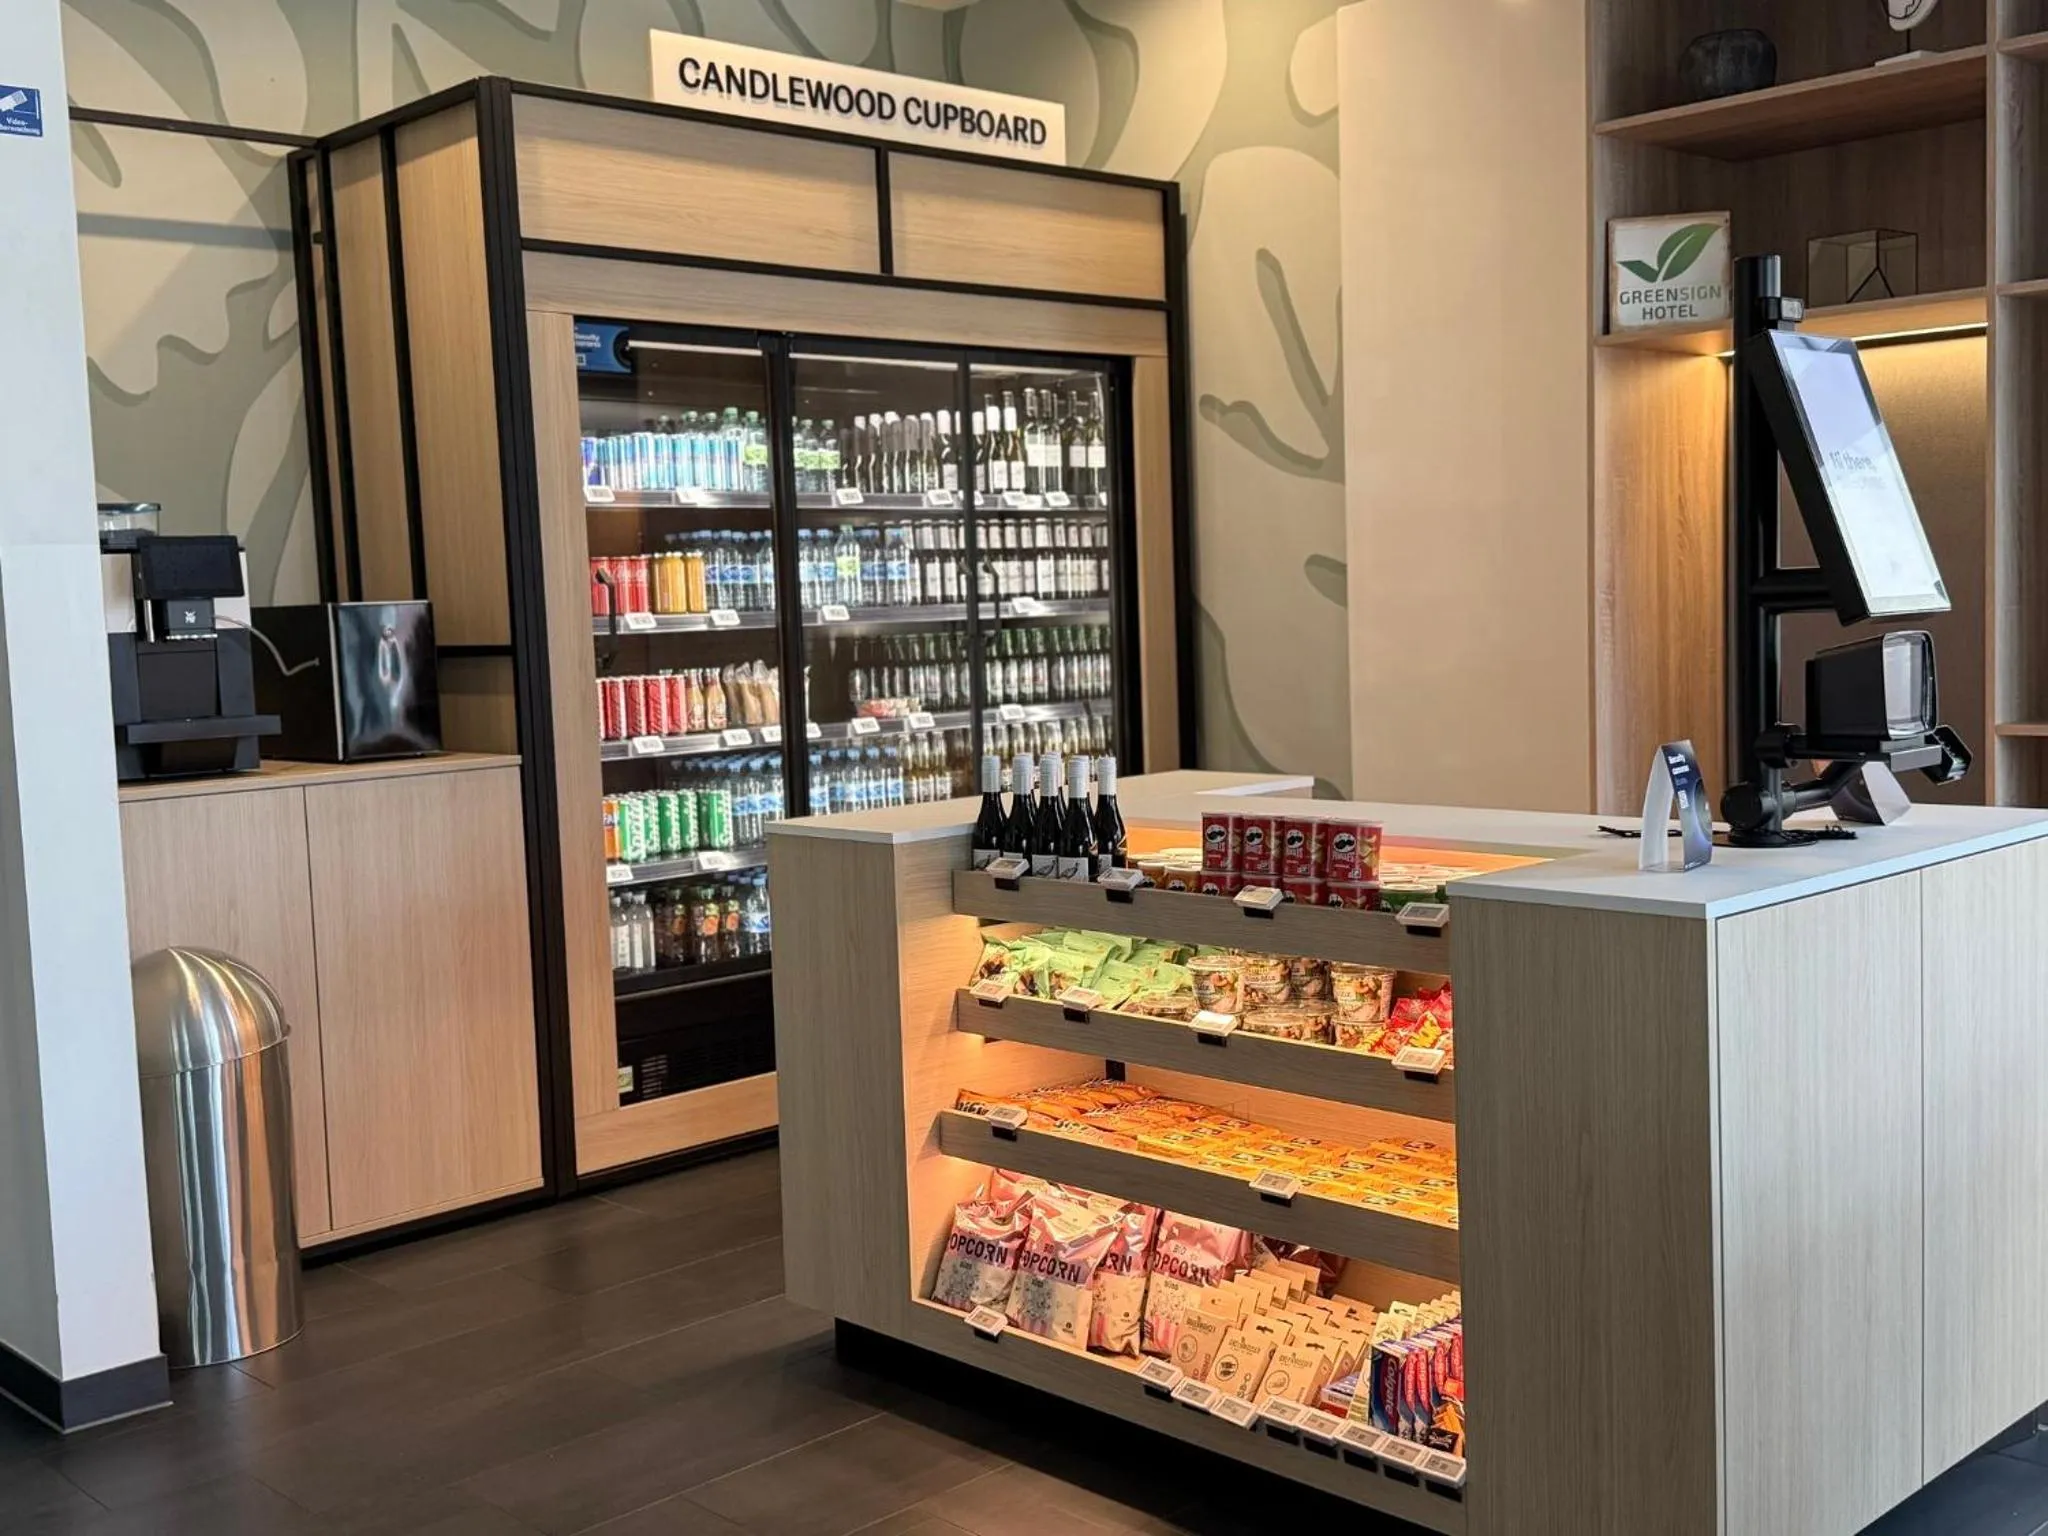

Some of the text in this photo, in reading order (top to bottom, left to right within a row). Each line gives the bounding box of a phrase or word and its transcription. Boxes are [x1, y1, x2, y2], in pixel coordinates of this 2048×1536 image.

[678, 57, 1047, 145] CANDLEWOOD CUPBOARD
[1620, 285, 1721, 305] GREENSIGN
[1642, 304, 1698, 320] HOTEL
[1385, 1357, 1398, 1414] Colgate
